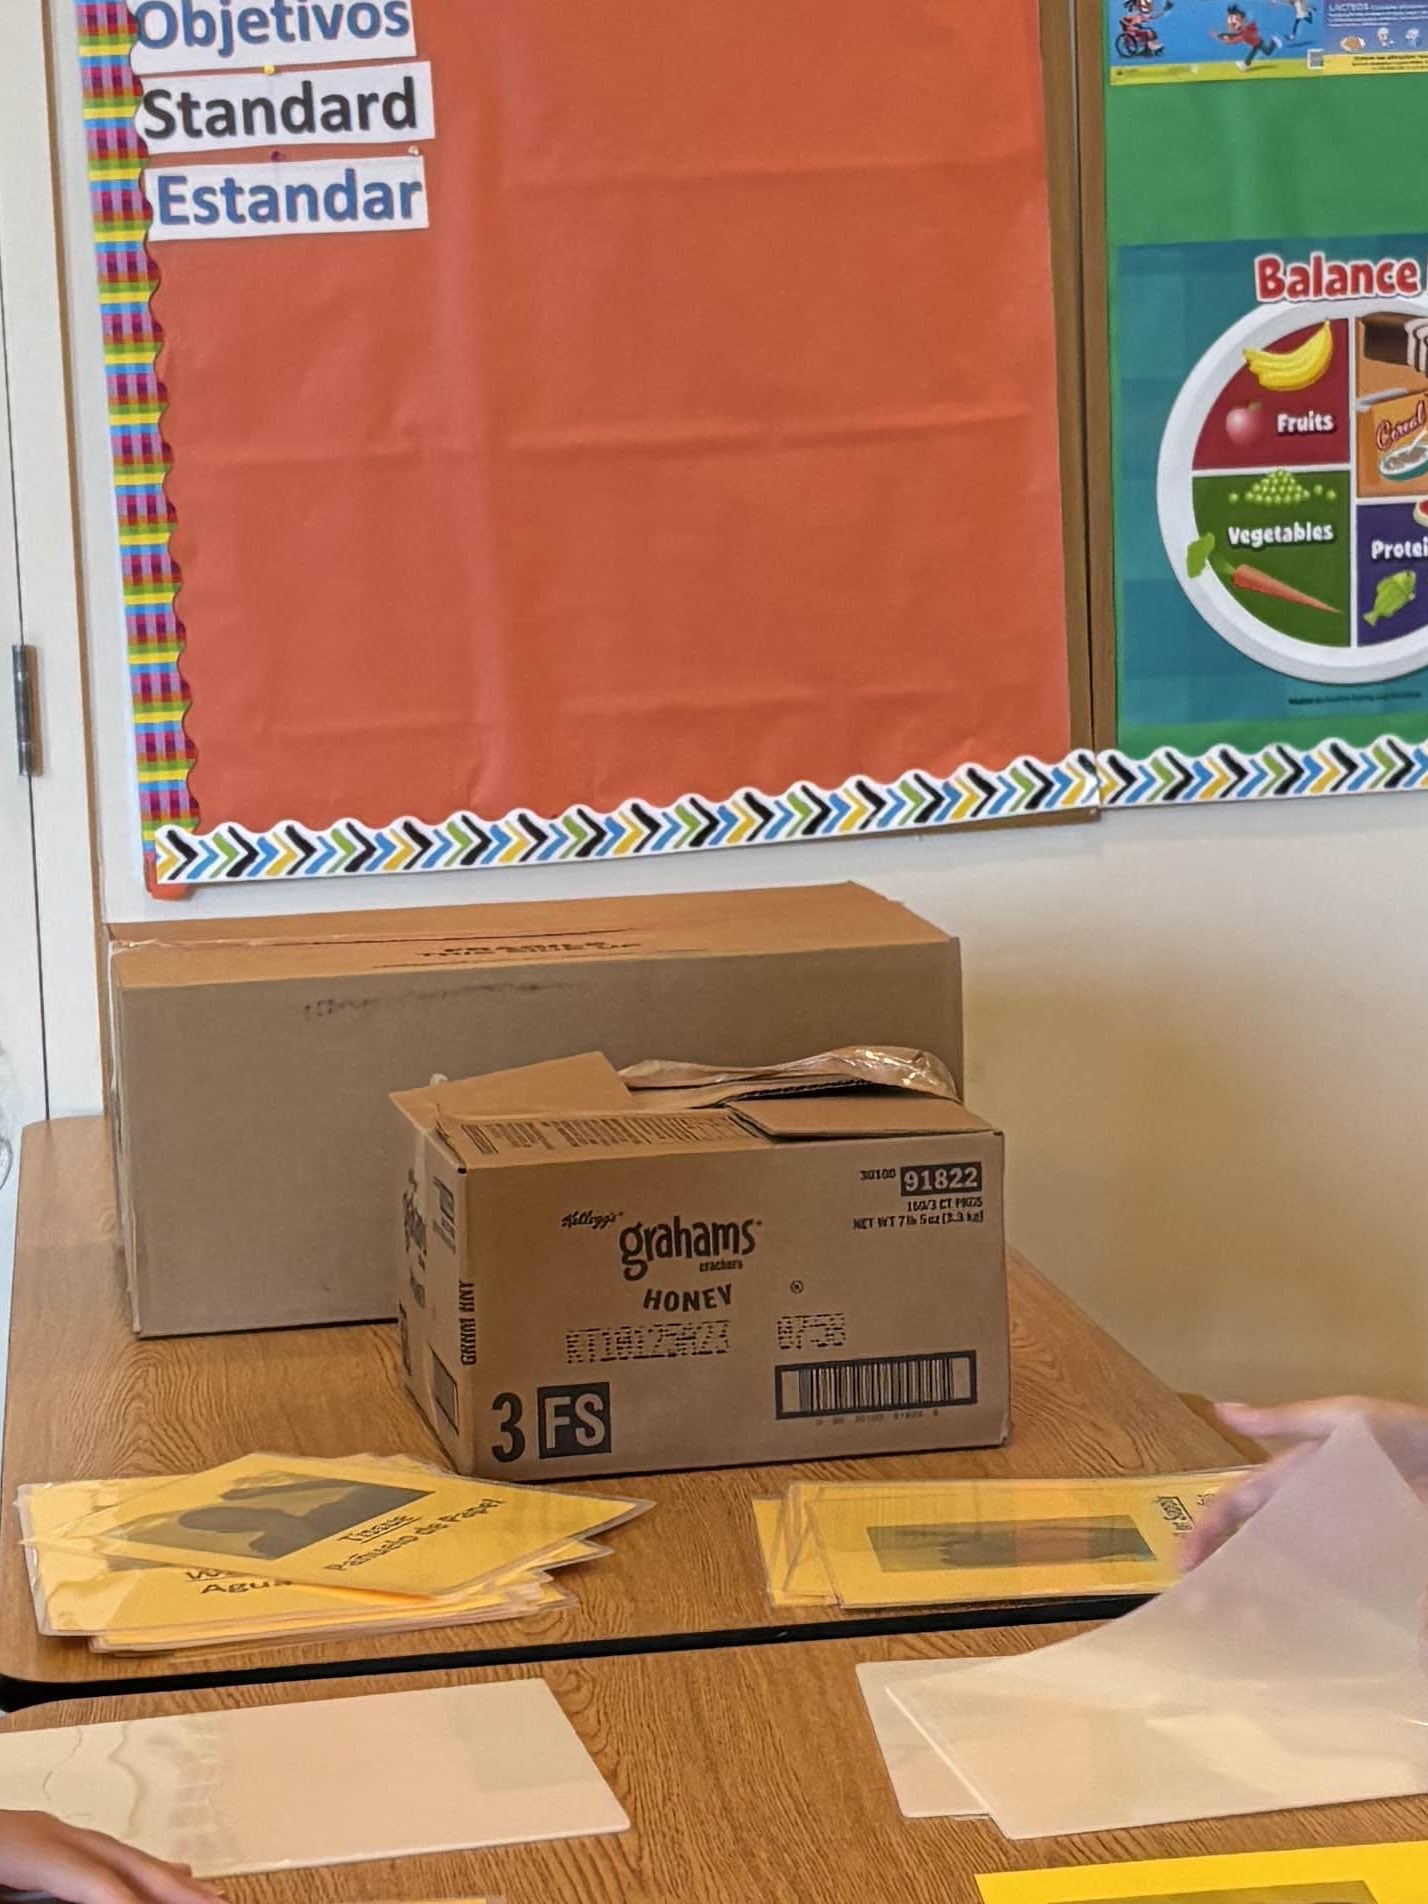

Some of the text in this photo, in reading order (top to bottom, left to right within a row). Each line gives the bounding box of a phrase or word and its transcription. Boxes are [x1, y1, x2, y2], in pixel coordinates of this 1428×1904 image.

[142, 76, 419, 141] Standard
[156, 168, 422, 226] Estandar
[1257, 253, 1419, 300] Balance
[1277, 412, 1334, 434] Fruits
[1227, 522, 1334, 549] Vegetables
[903, 1166, 979, 1193] 91822
[619, 1215, 757, 1281] grahams
[699, 1259, 743, 1273] crackers
[642, 1283, 732, 1312] HONEY
[492, 1392, 608, 1463] 3 FS
